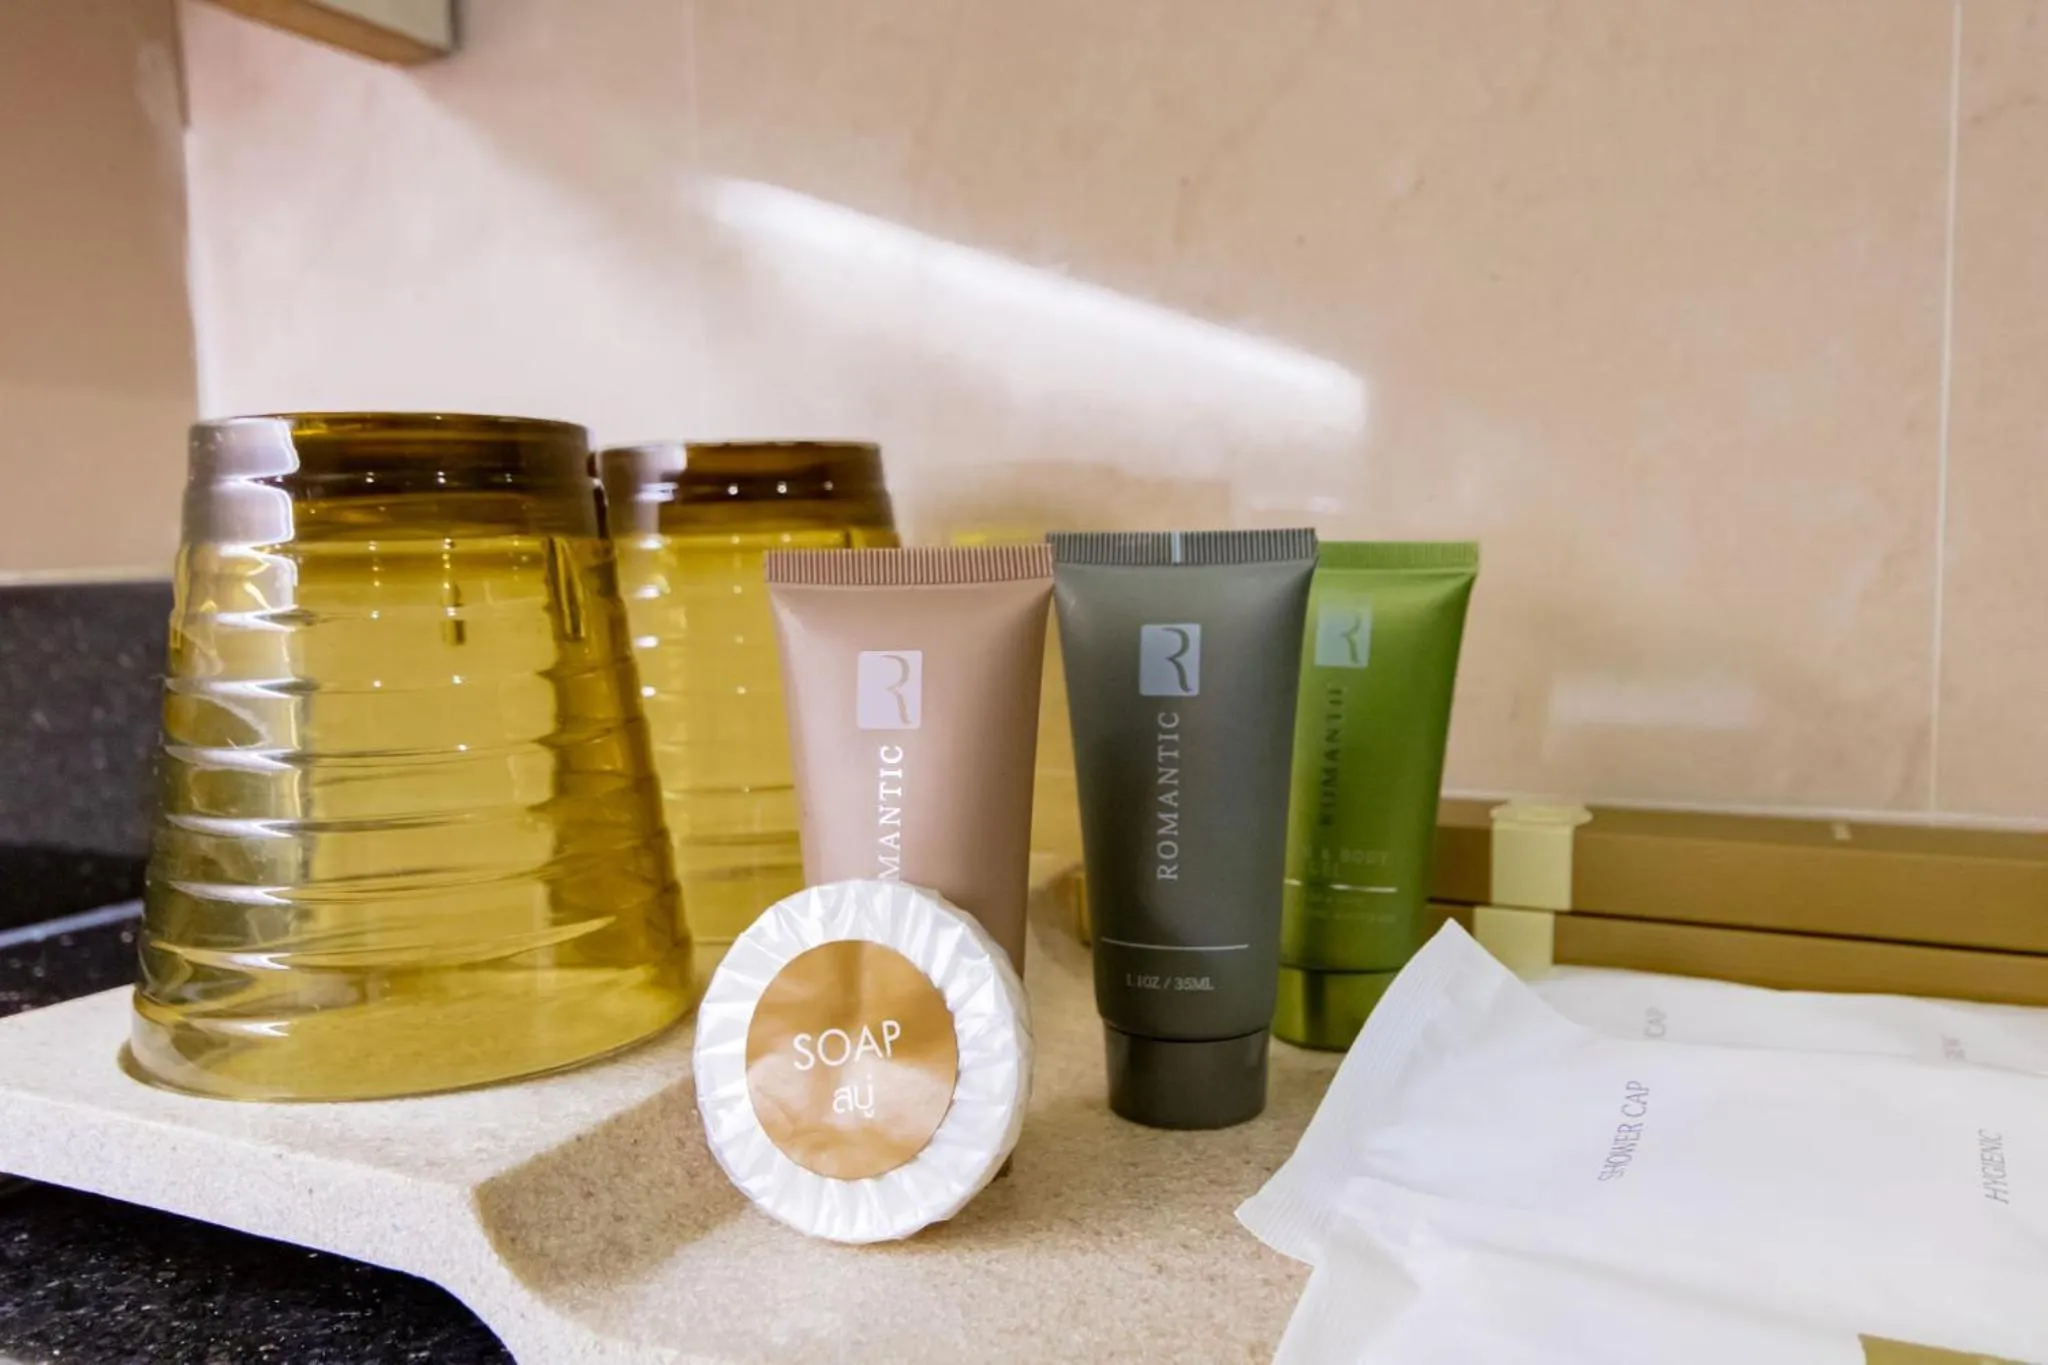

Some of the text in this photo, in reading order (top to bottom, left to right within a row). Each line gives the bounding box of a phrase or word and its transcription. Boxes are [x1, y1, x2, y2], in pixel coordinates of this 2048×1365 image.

[877, 744, 904, 881] MANTIC
[1156, 710, 1180, 881] ROMANTIC
[1174, 976, 1216, 991] 35ML
[792, 1019, 902, 1071] SOAP
[1597, 1079, 1650, 1182] SHOWER CAP
[1977, 1127, 2010, 1207] HYGIENIC
